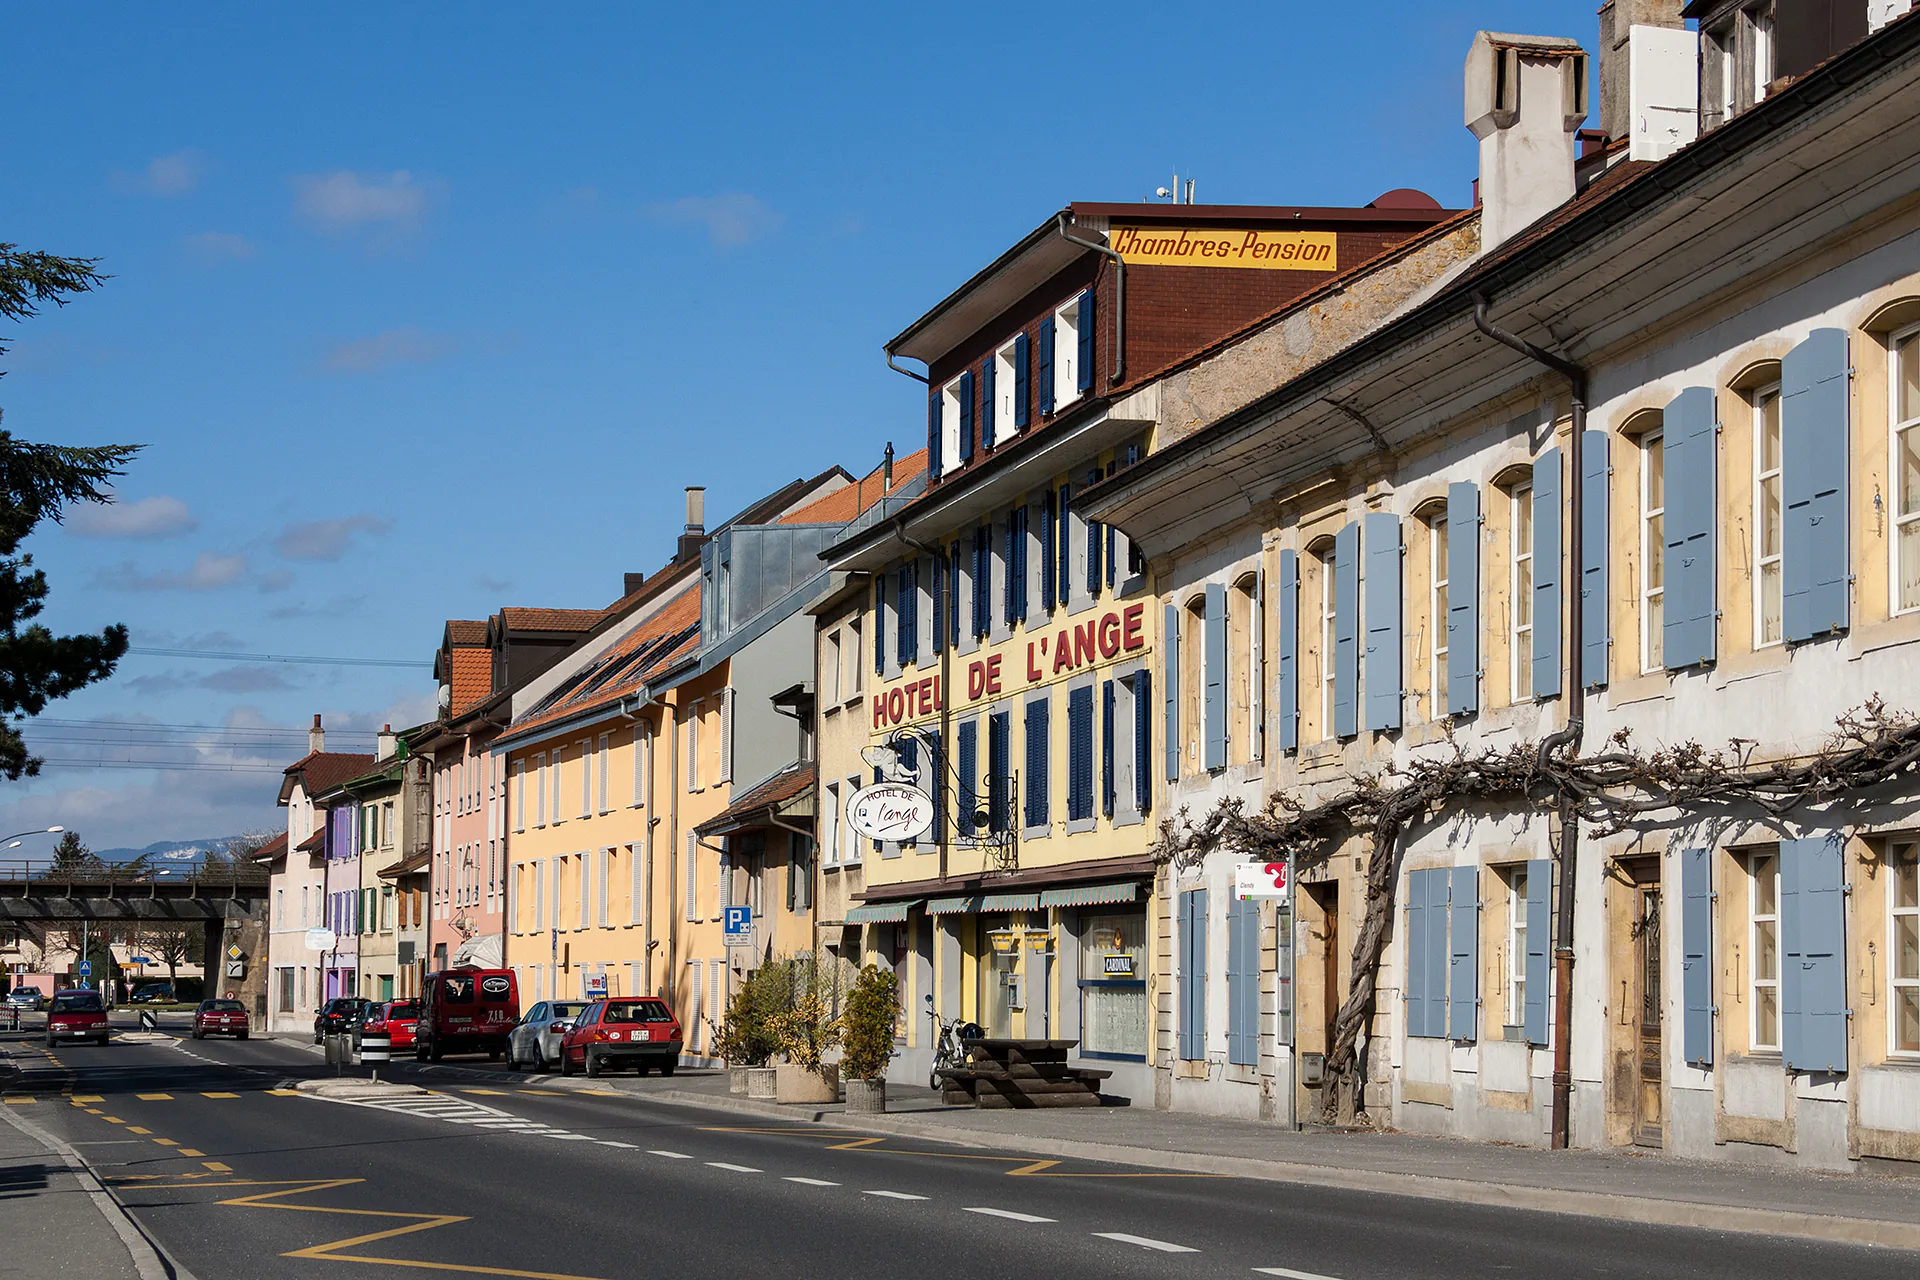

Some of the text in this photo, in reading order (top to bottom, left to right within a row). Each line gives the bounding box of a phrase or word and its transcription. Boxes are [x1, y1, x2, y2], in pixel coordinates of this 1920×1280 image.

[1114, 226, 1331, 262] Chambres-Pension
[873, 602, 1144, 728] HOTEL DE L'ANGE
[866, 790, 915, 802] HOTEL DE
[877, 803, 922, 832] l'ange
[729, 910, 742, 929] P
[1106, 958, 1131, 971] CARDINAL
